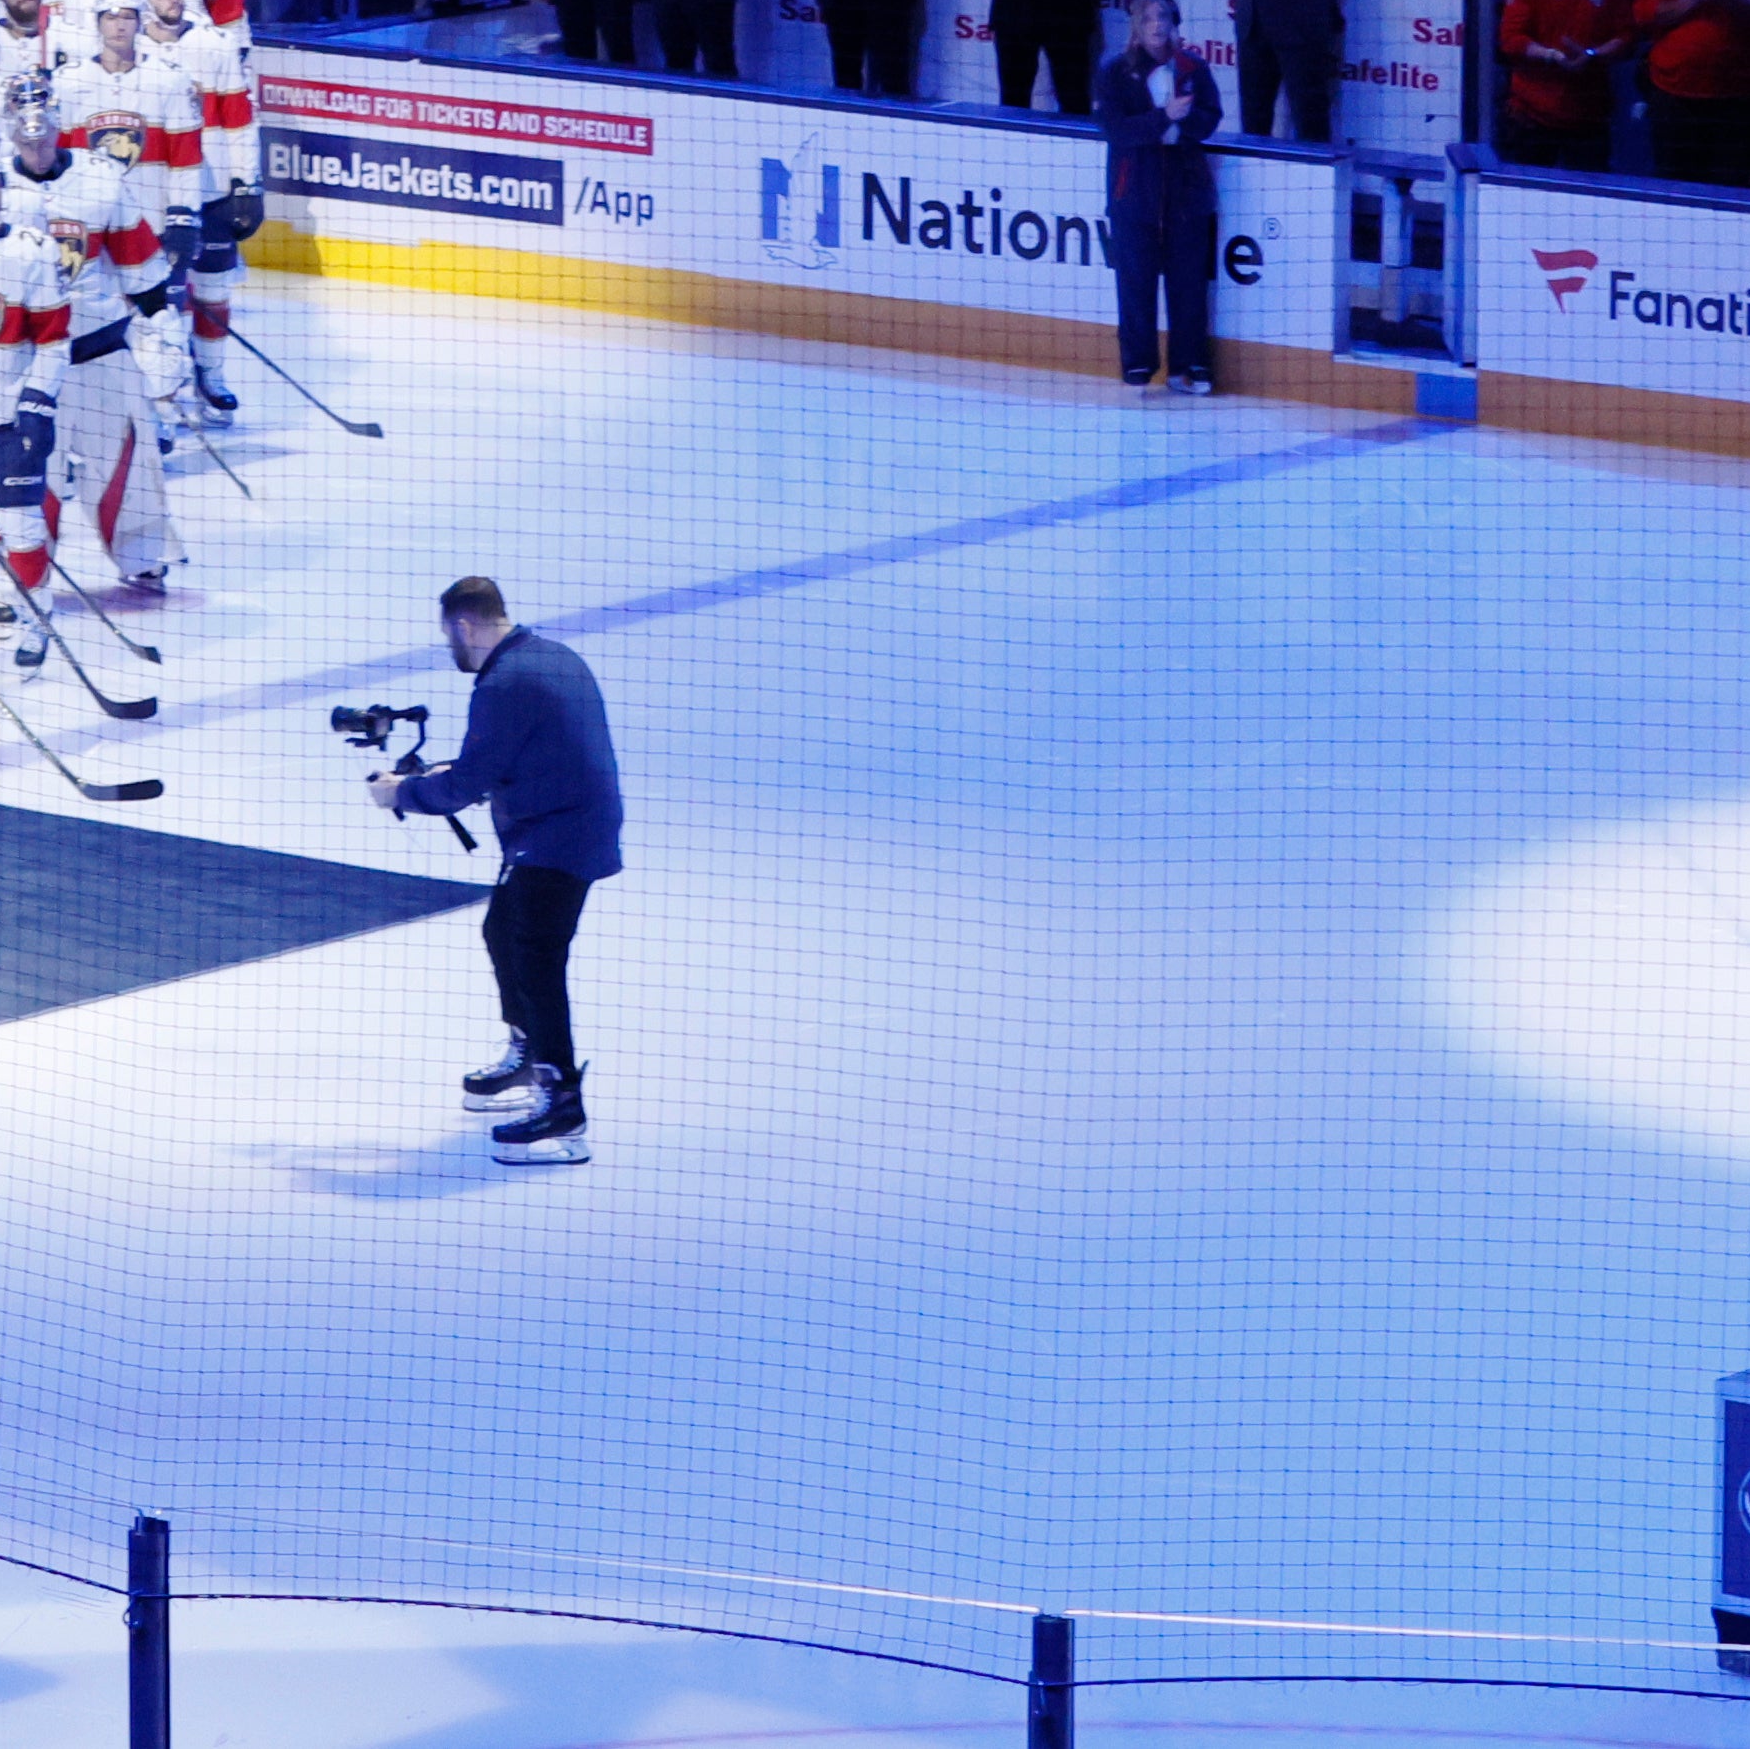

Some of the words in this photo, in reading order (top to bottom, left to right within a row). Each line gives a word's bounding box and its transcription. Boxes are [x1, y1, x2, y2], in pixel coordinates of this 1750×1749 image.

[1334, 58, 1439, 92] afelite
[262, 84, 371, 115] DOWNLOAD
[373, 97, 413, 120] FOR
[416, 101, 496, 130] TICKETS
[497, 111, 541, 135] AND
[543, 116, 648, 147] SCHEDULE
[268, 143, 554, 211] BlueJackets.com
[861, 171, 1264, 286] Natione
